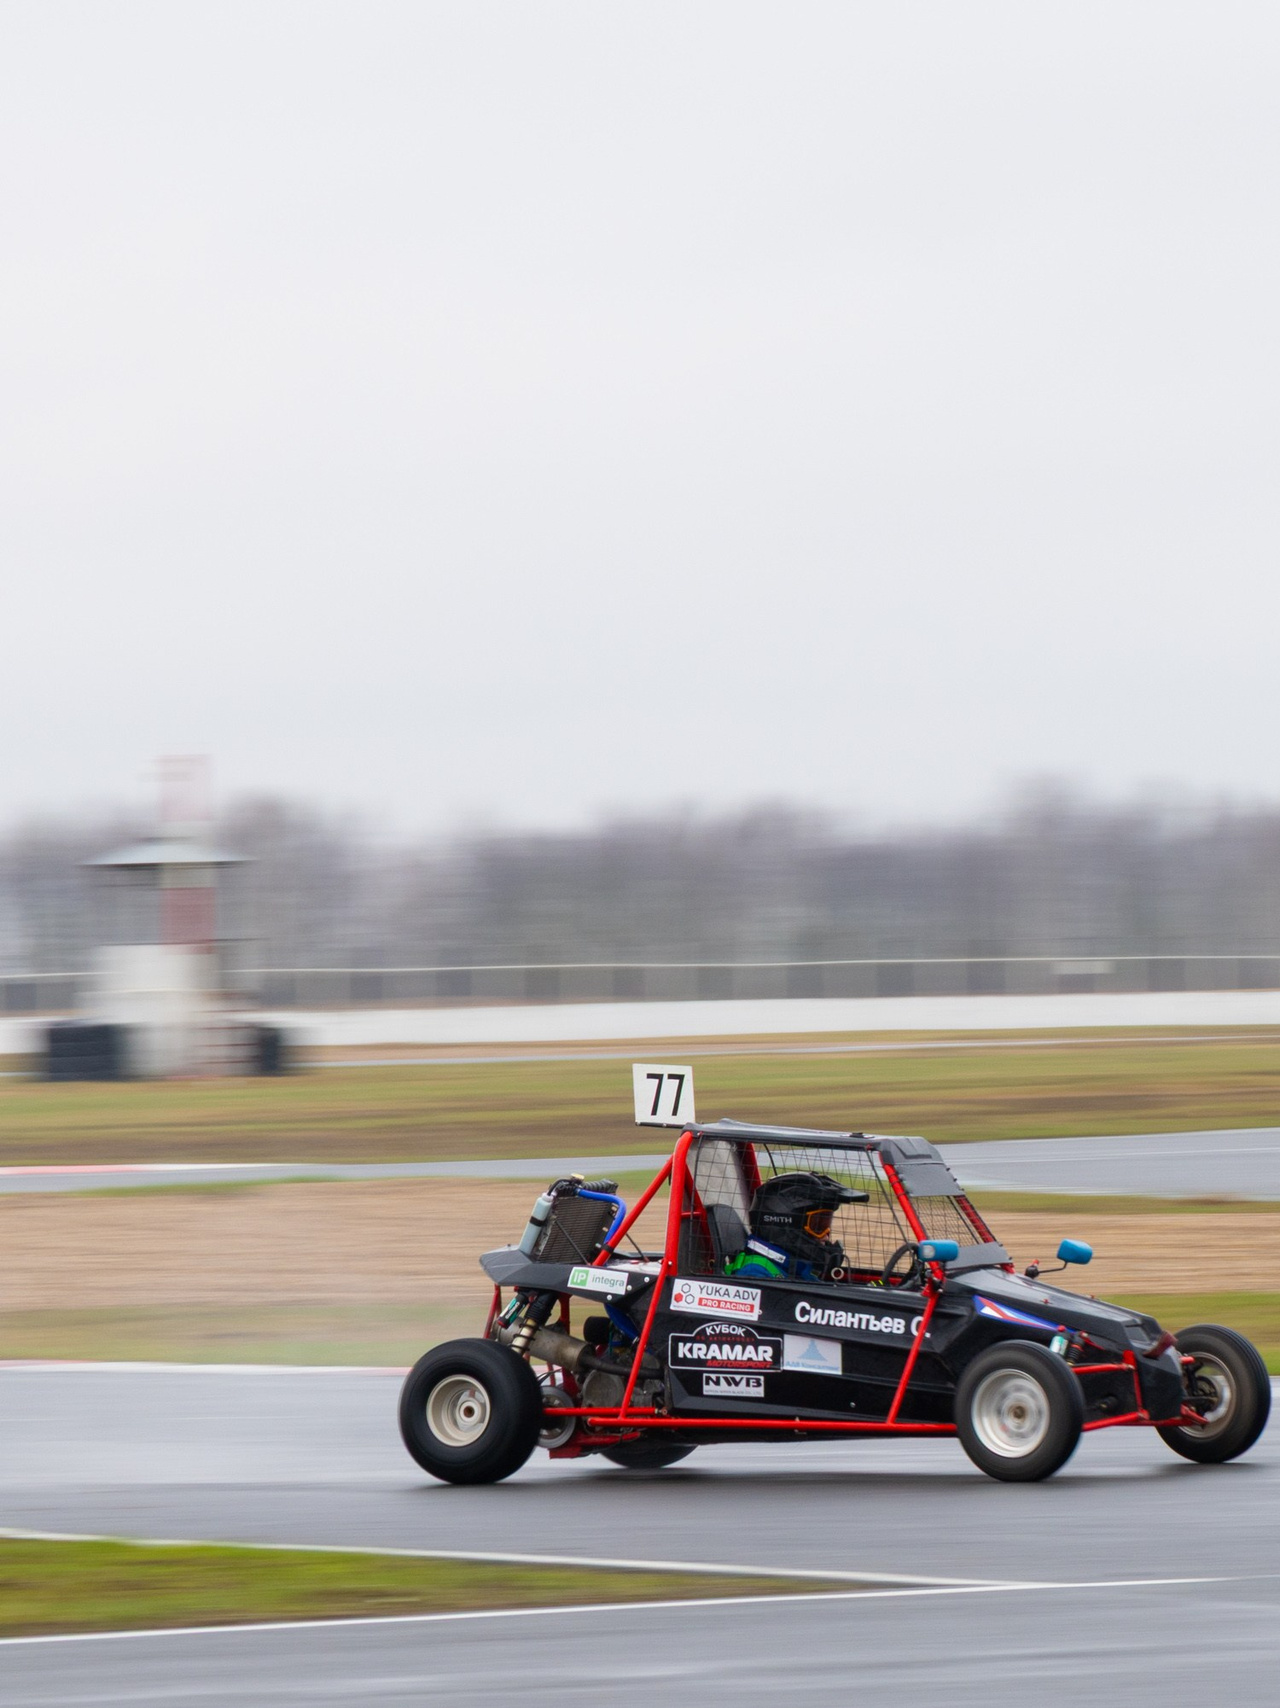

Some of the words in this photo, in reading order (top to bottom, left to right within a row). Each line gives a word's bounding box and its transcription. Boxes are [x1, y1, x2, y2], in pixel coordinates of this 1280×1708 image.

[646, 1073, 685, 1116] 77
[763, 1214, 792, 1223] SMITH
[573, 1271, 586, 1284] IP
[592, 1275, 624, 1287] integra
[699, 1284, 730, 1298] YUKA
[733, 1289, 758, 1301] ADV
[701, 1298, 719, 1307] PRO
[720, 1301, 751, 1312] RACING
[794, 1301, 906, 1334] Силантьев
[705, 1324, 746, 1337] КУБОК
[678, 1342, 773, 1362] KRAMAR
[706, 1360, 773, 1369] MOTORSPORT
[705, 1375, 762, 1388] NWB
